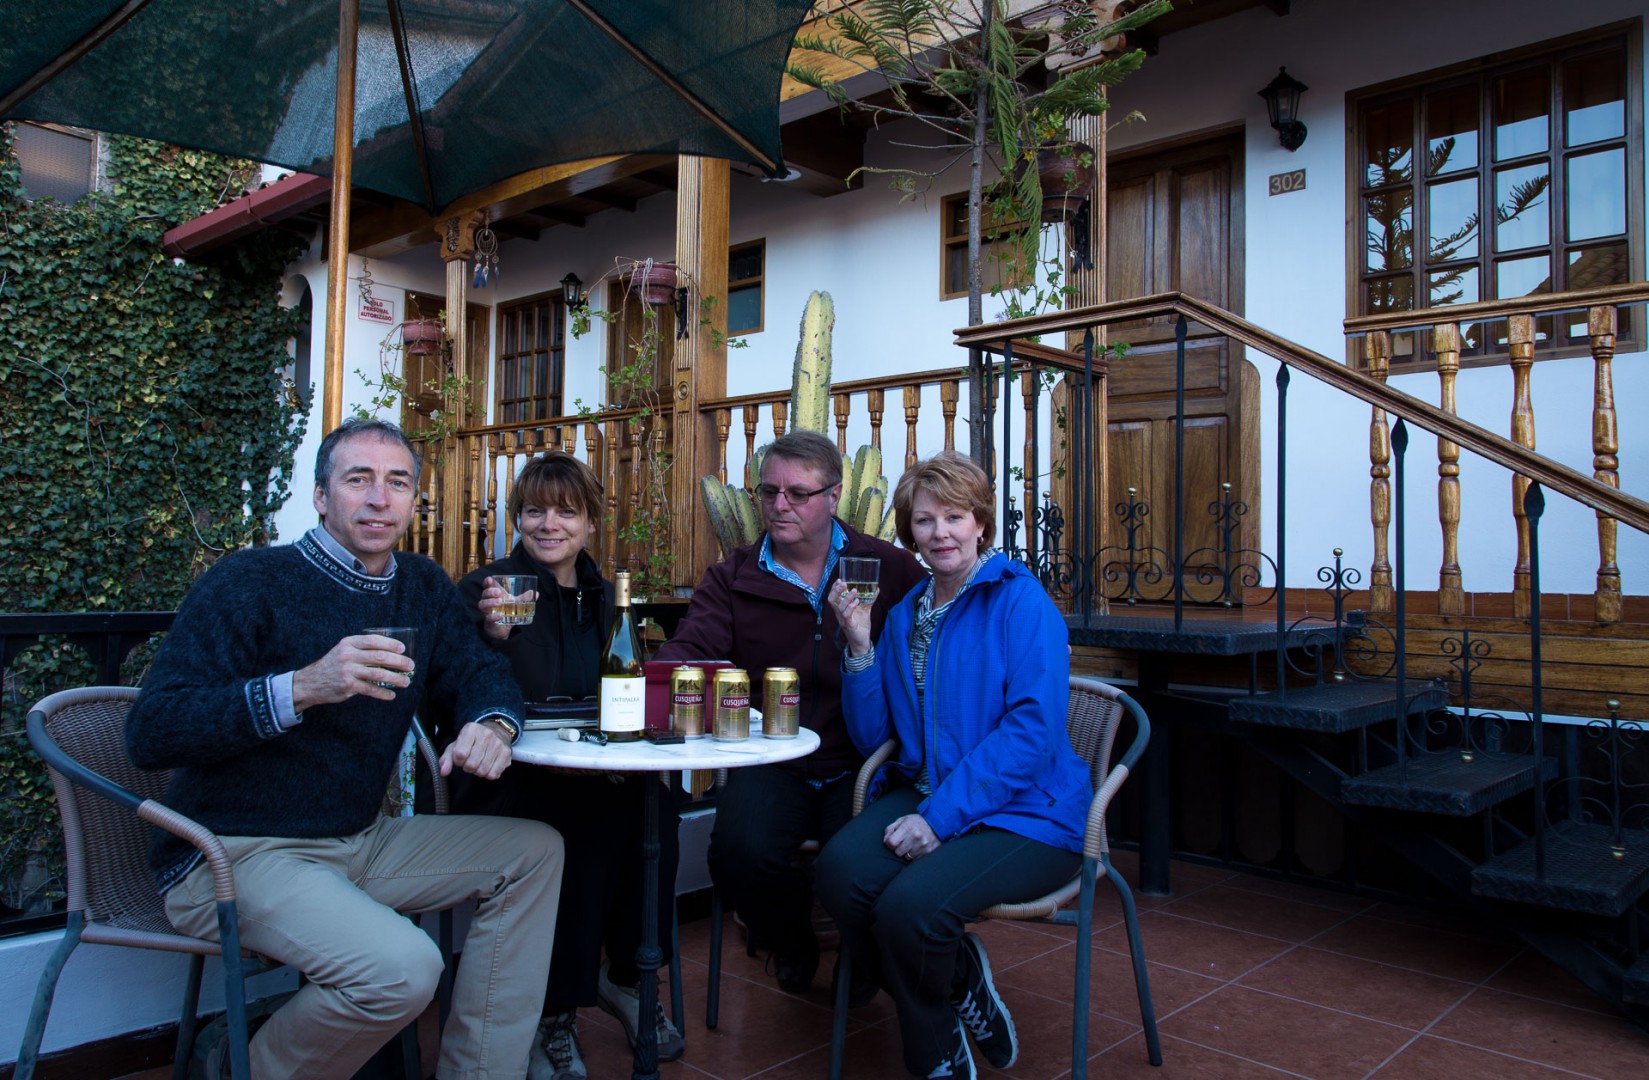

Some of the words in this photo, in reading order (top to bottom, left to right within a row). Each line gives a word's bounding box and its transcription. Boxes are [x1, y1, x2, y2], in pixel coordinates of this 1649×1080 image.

[1271, 171, 1304, 194] 302
[363, 305, 389, 314] PERSONAL
[360, 311, 392, 321] AUTORIZADO
[675, 695, 702, 703] CUSQUEÑA
